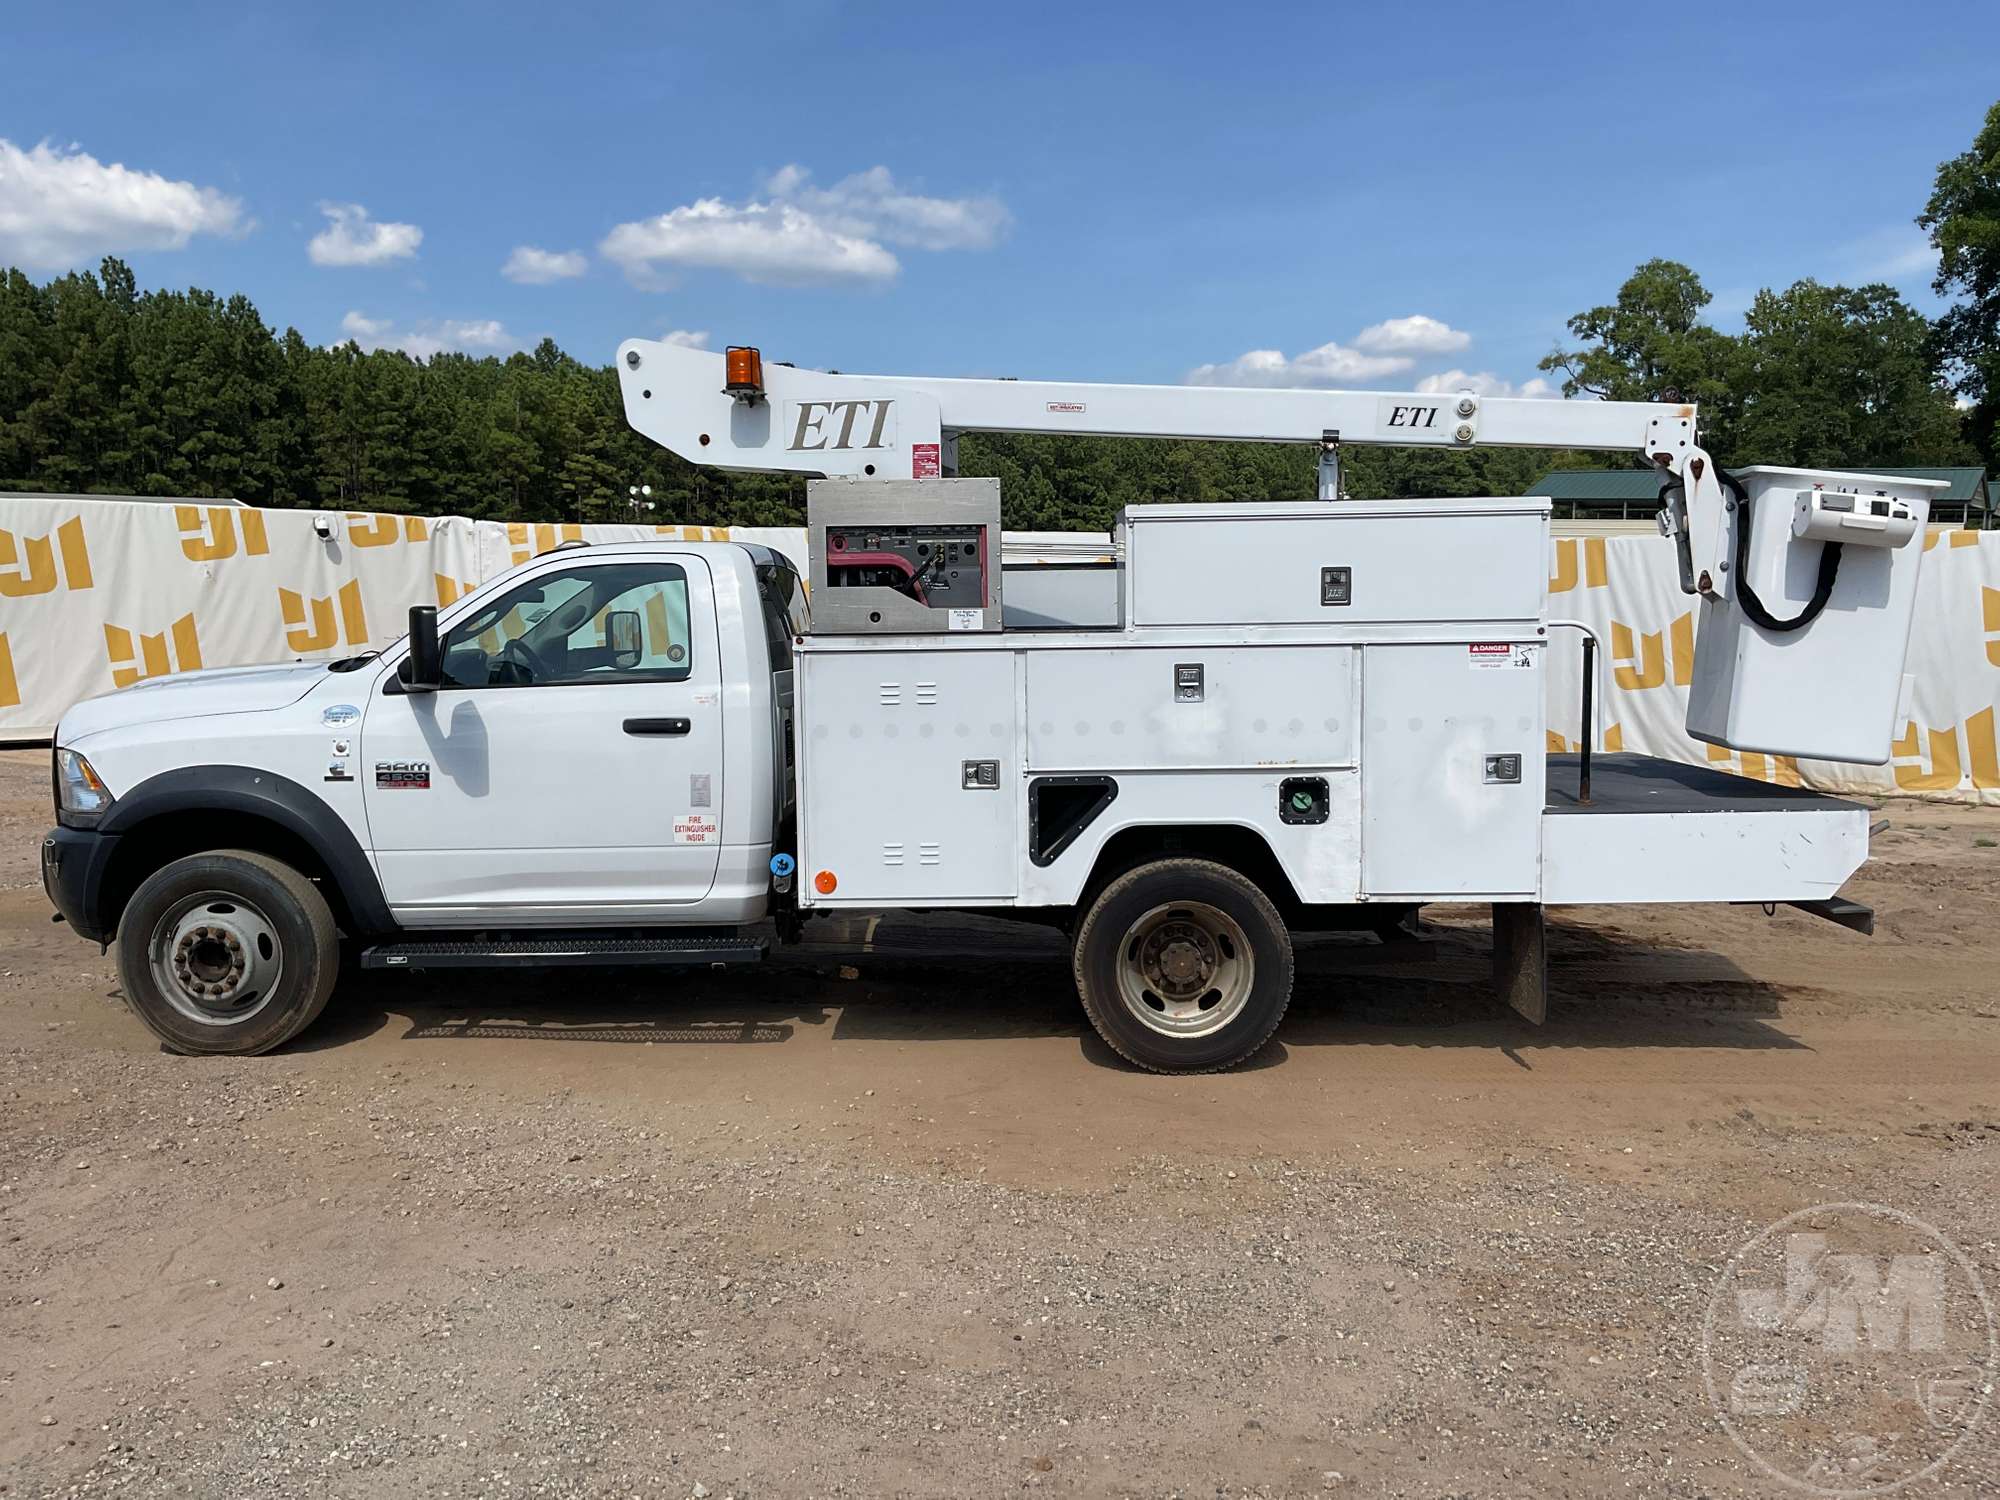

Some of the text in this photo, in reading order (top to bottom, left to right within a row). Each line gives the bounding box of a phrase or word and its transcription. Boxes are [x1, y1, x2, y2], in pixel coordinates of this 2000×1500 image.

[1387, 406, 1439, 427] ETI
[786, 399, 896, 451] ETI
[689, 816, 702, 824] FIRE
[674, 824, 716, 833] EXTINGUISHER
[687, 833, 705, 842] INSIDE
